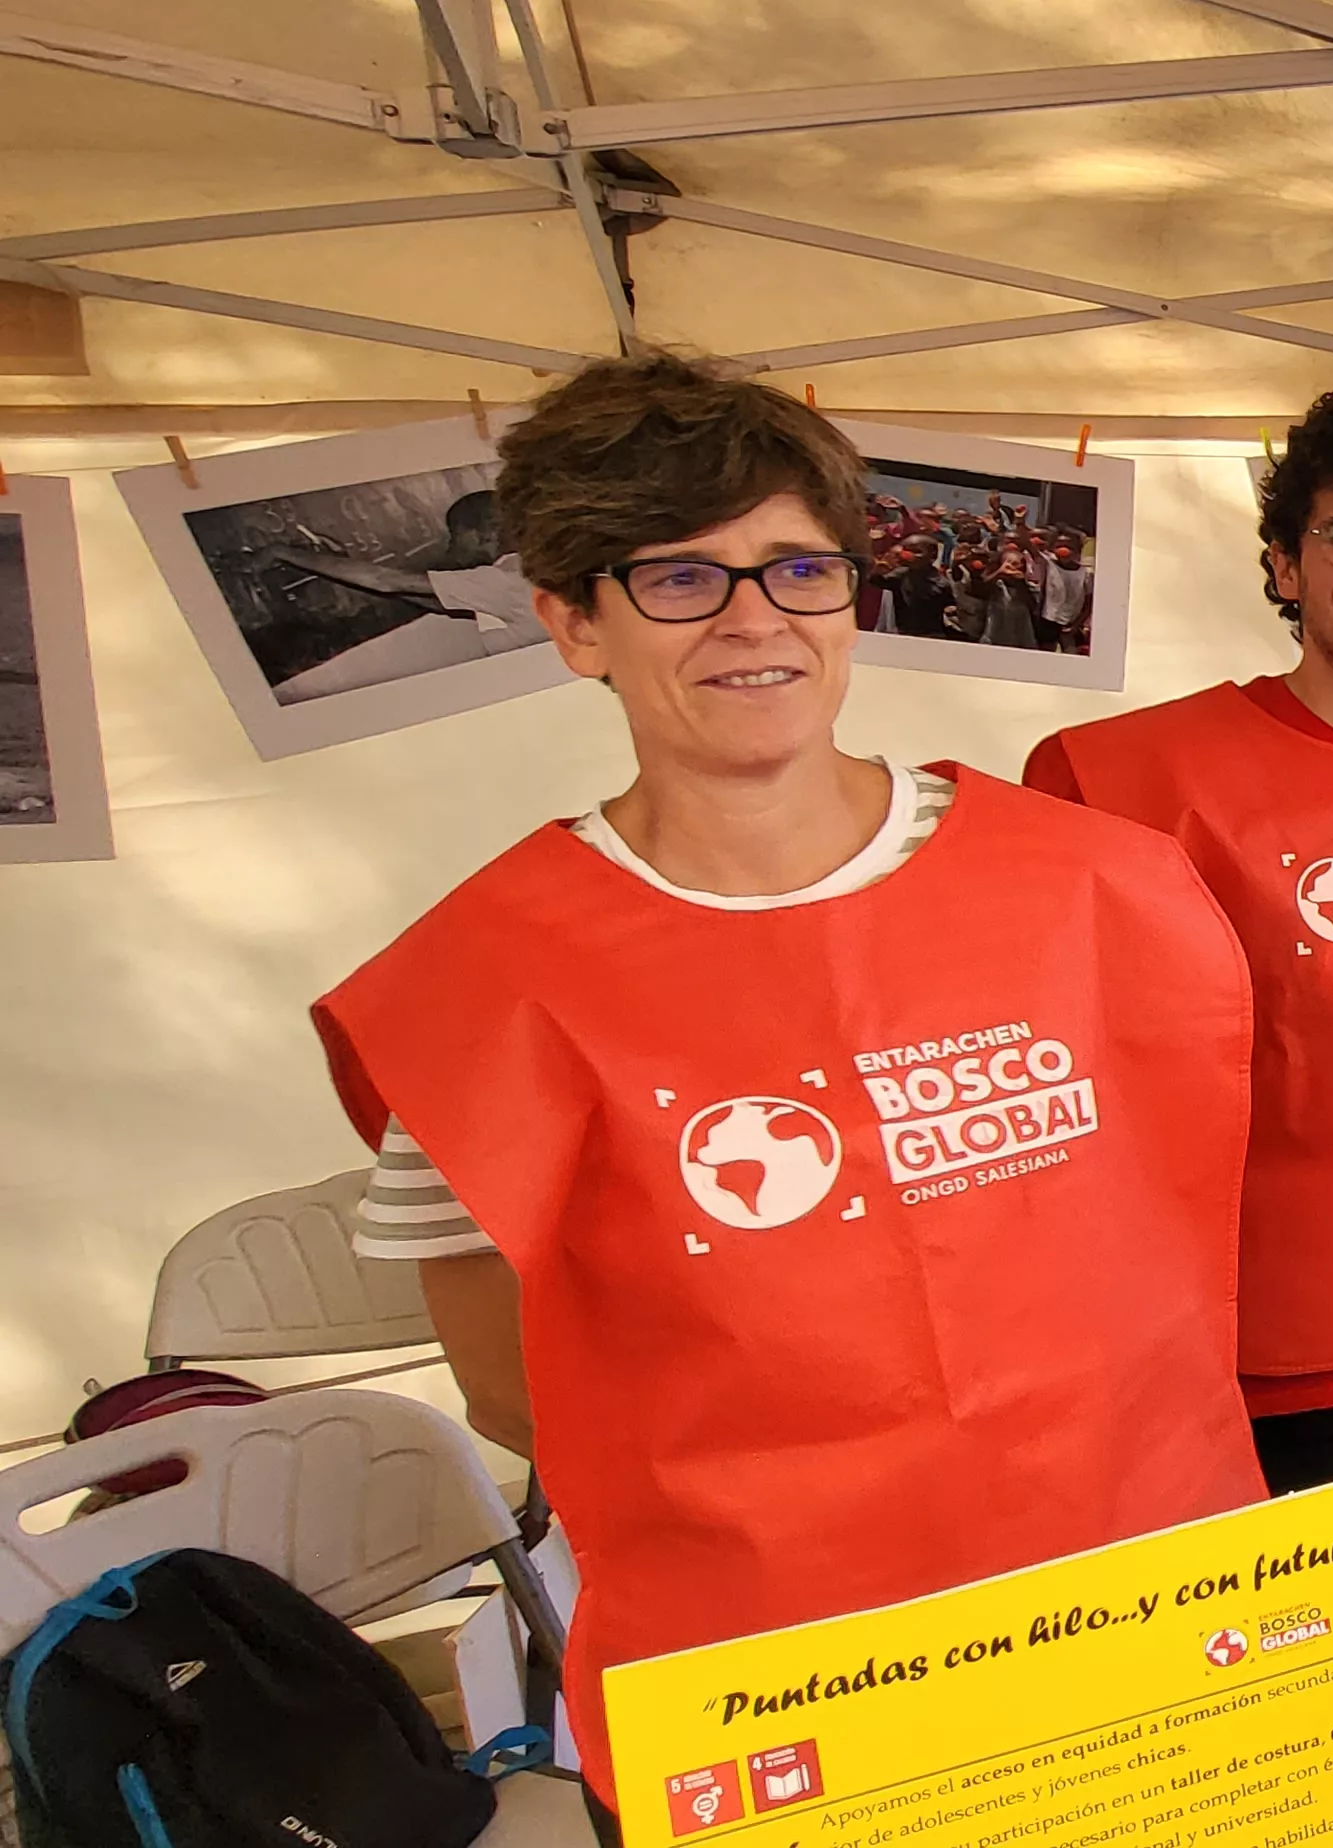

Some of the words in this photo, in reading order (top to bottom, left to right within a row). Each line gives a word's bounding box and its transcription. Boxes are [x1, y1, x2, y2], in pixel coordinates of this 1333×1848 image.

[853, 1021, 1032, 1073] ENTARACHEN
[864, 1038, 1073, 1121] BOSCO
[894, 1088, 1093, 1172] GLOBAL
[901, 1175, 968, 1205] ONGD
[975, 1148, 1069, 1186] SALESIANA
[942, 1634, 1015, 1671] con
[1173, 1571, 1242, 1608] con
[1260, 1608, 1321, 1635] BOSCO
[1262, 1621, 1330, 1651] GLOBAL
[670, 1779, 681, 1794] 5
[752, 1756, 762, 1771] 4
[820, 1787, 933, 1831] Apoyamos
[936, 1776, 955, 1797] el
[960, 1761, 1026, 1790] acceso
[1030, 1752, 1056, 1770] en
[1060, 1722, 1144, 1761] equidad
[1148, 1722, 1160, 1736] a
[1163, 1692, 1263, 1732] formación
[976, 1801, 1108, 1848] participación
[1110, 1792, 1136, 1810] en
[1139, 1783, 1166, 1801] un
[1169, 1766, 1222, 1792] taller
[1225, 1756, 1250, 1775] de
[1252, 1735, 1327, 1767] costura,
[867, 1827, 894, 1847] de
[898, 1790, 1027, 1838] adolescentes
[1031, 1785, 1044, 1804] y
[1047, 1762, 1123, 1799] jóvenes
[1125, 1743, 1192, 1771] chicas.
[1141, 1806, 1185, 1834] para
[1188, 1775, 1282, 1814] completar
[1285, 1764, 1320, 1784] con
[1185, 1830, 1198, 1848] y
[1202, 1789, 1319, 1839] universidad.
